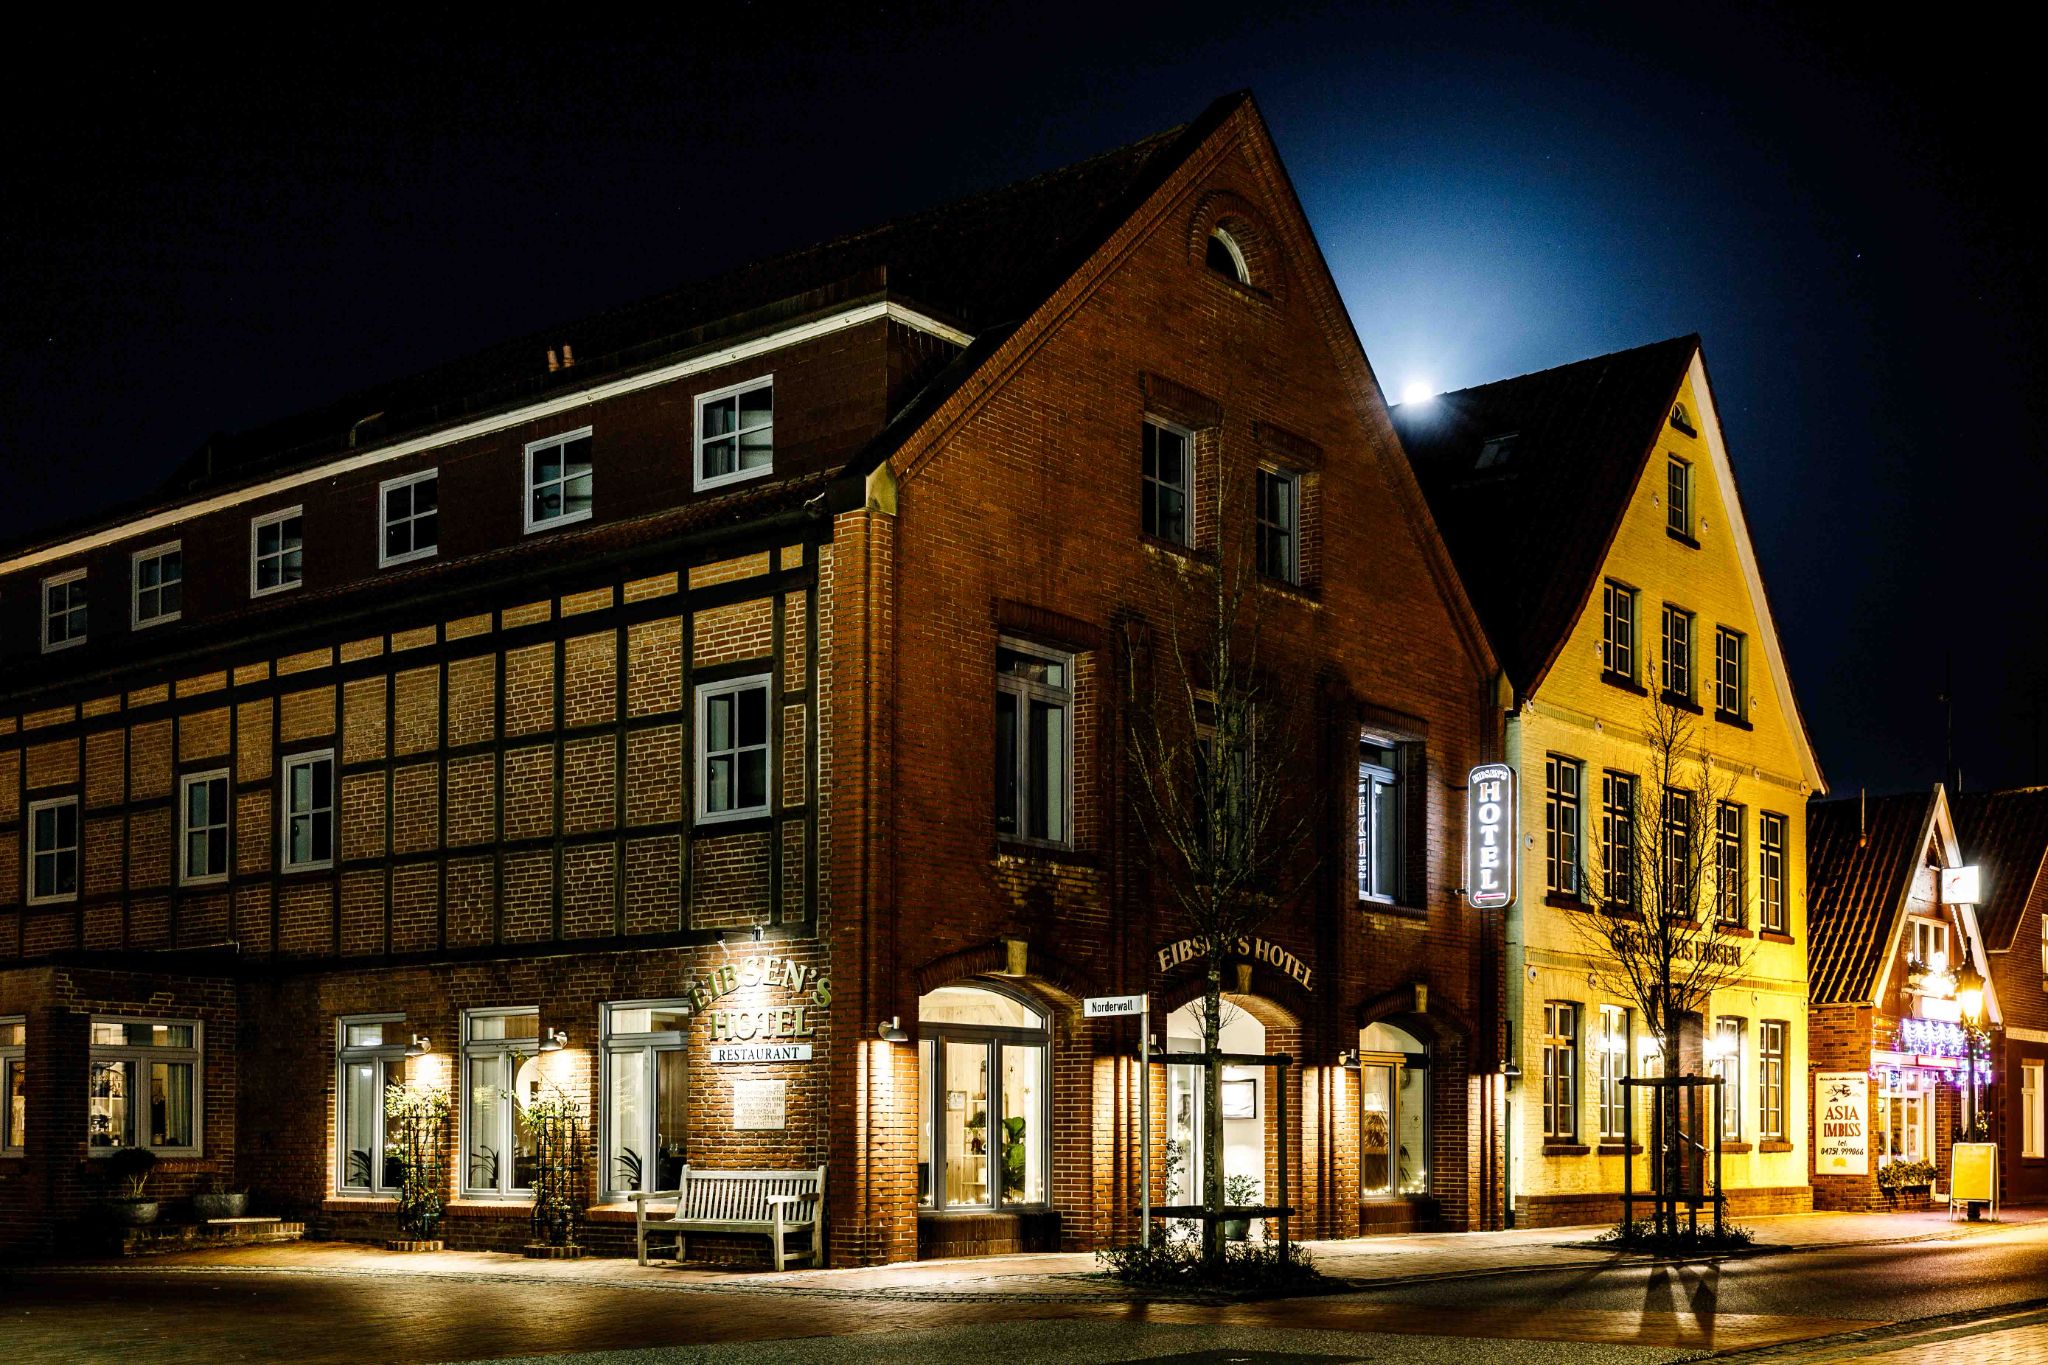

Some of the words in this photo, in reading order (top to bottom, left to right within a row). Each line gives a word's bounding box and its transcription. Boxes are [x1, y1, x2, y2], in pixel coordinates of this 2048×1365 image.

[1479, 782, 1500, 889] HOTEL
[1157, 935, 1249, 972] EIBSS
[1254, 937, 1313, 991] HOTEL
[688, 956, 832, 1013] EIBSEN'S
[1091, 1000, 1133, 1013] Norderwall
[710, 1007, 813, 1041] HOTEL
[718, 1047, 800, 1061] RESTAURANT
[1824, 1105, 1859, 1121] ASIA
[1823, 1122, 1861, 1137] IMBISS
